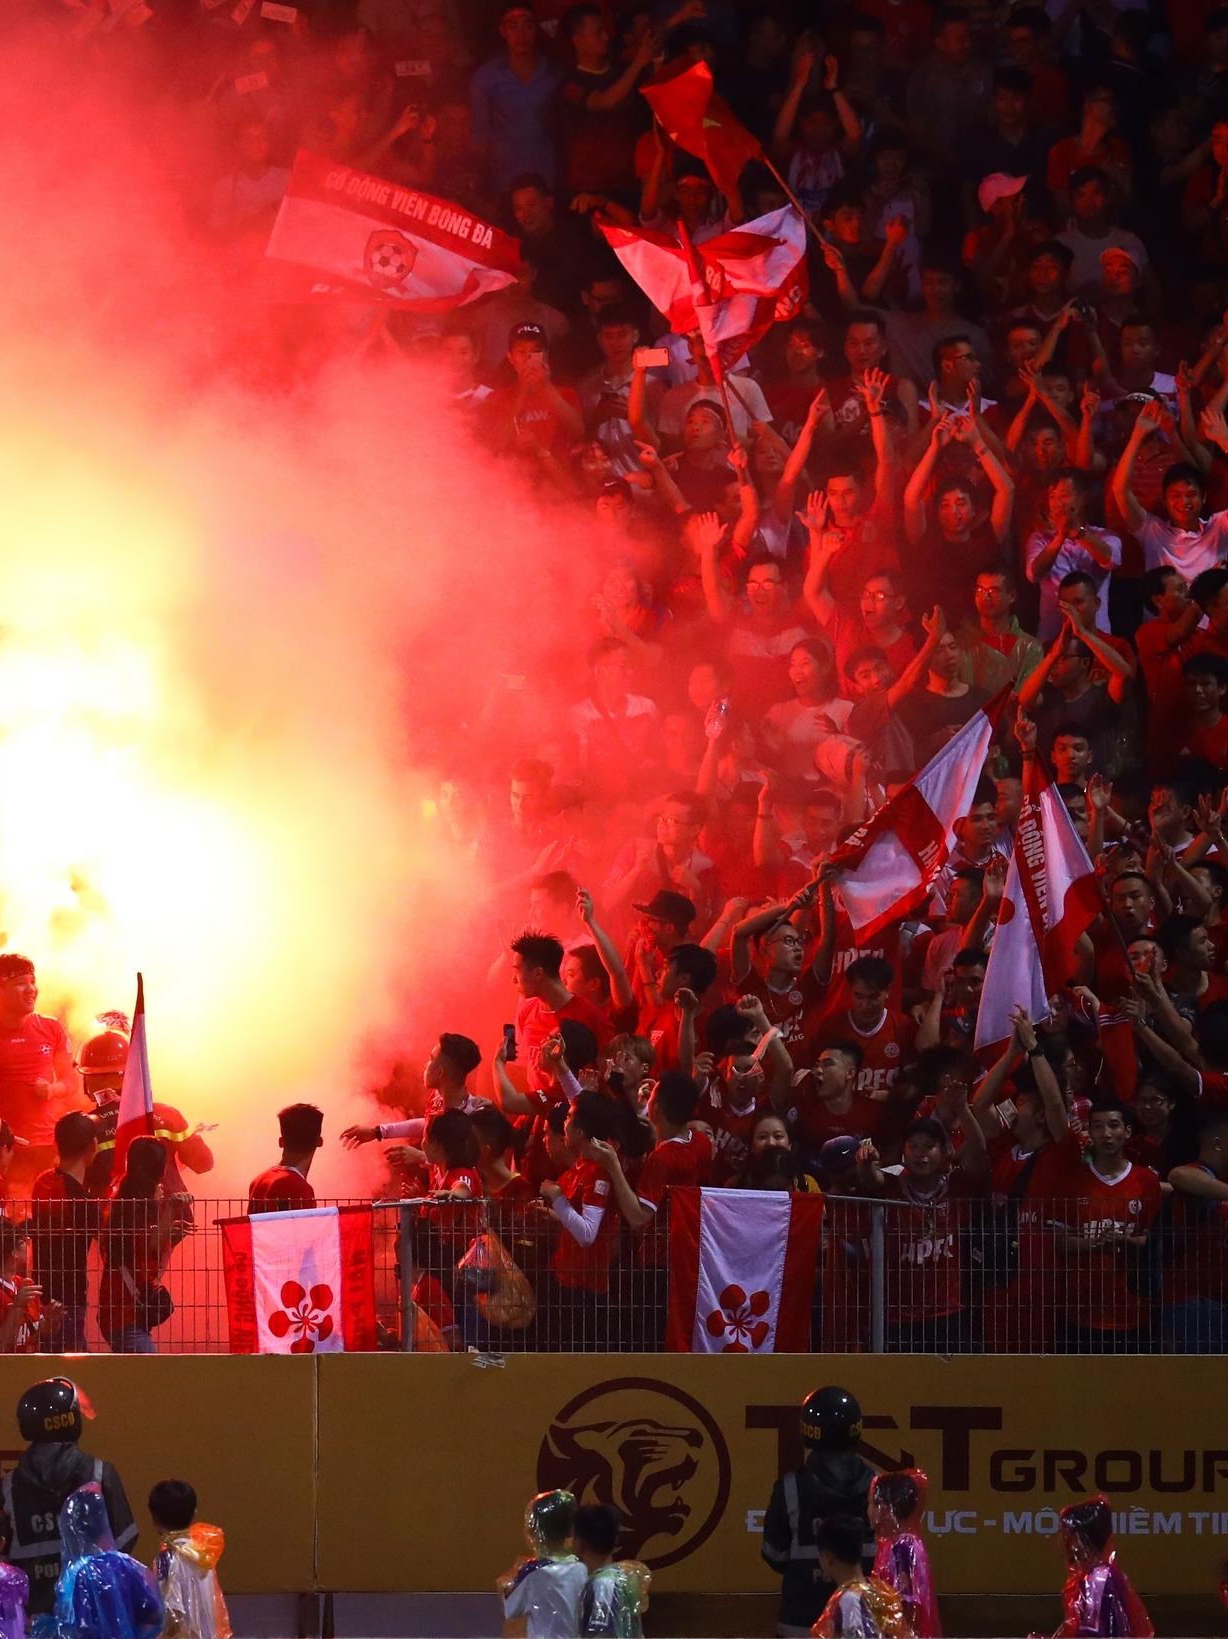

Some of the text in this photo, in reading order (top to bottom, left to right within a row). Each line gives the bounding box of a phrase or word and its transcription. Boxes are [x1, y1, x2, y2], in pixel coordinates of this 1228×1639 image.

[925, 1510, 977, 1538] ỰC
[1003, 1506, 1060, 1538] MỘ
[1111, 1504, 1181, 1535] IỀM
[1188, 1511, 1228, 1535] TI
